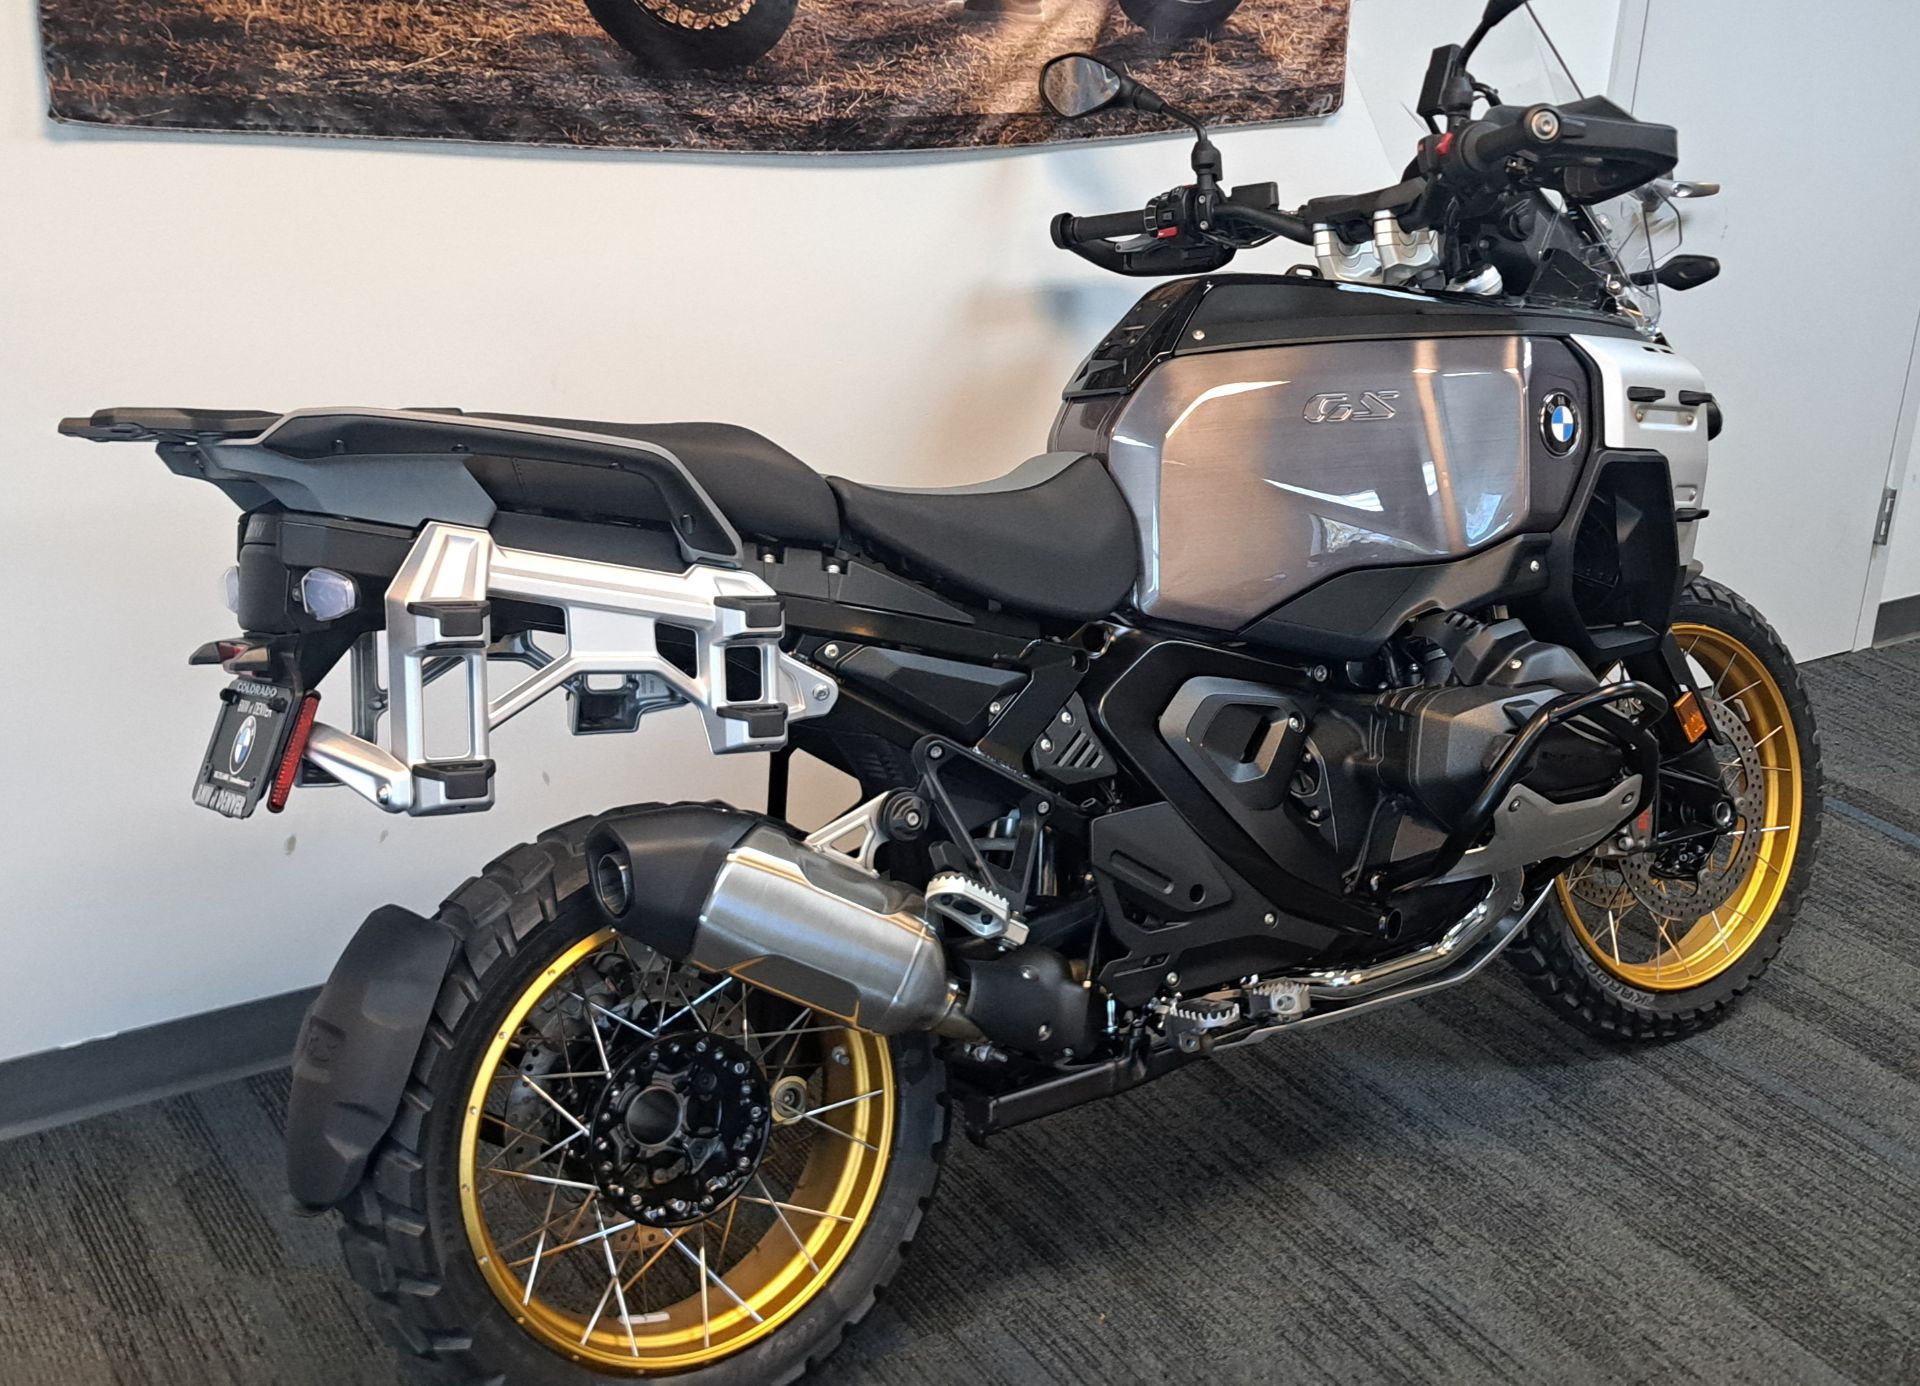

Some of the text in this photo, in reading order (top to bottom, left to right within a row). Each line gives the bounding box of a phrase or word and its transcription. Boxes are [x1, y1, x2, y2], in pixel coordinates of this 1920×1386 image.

[1303, 390, 1400, 424] GS
[236, 682, 277, 698] COLORADO
[1586, 962, 1648, 1005] KAROO
